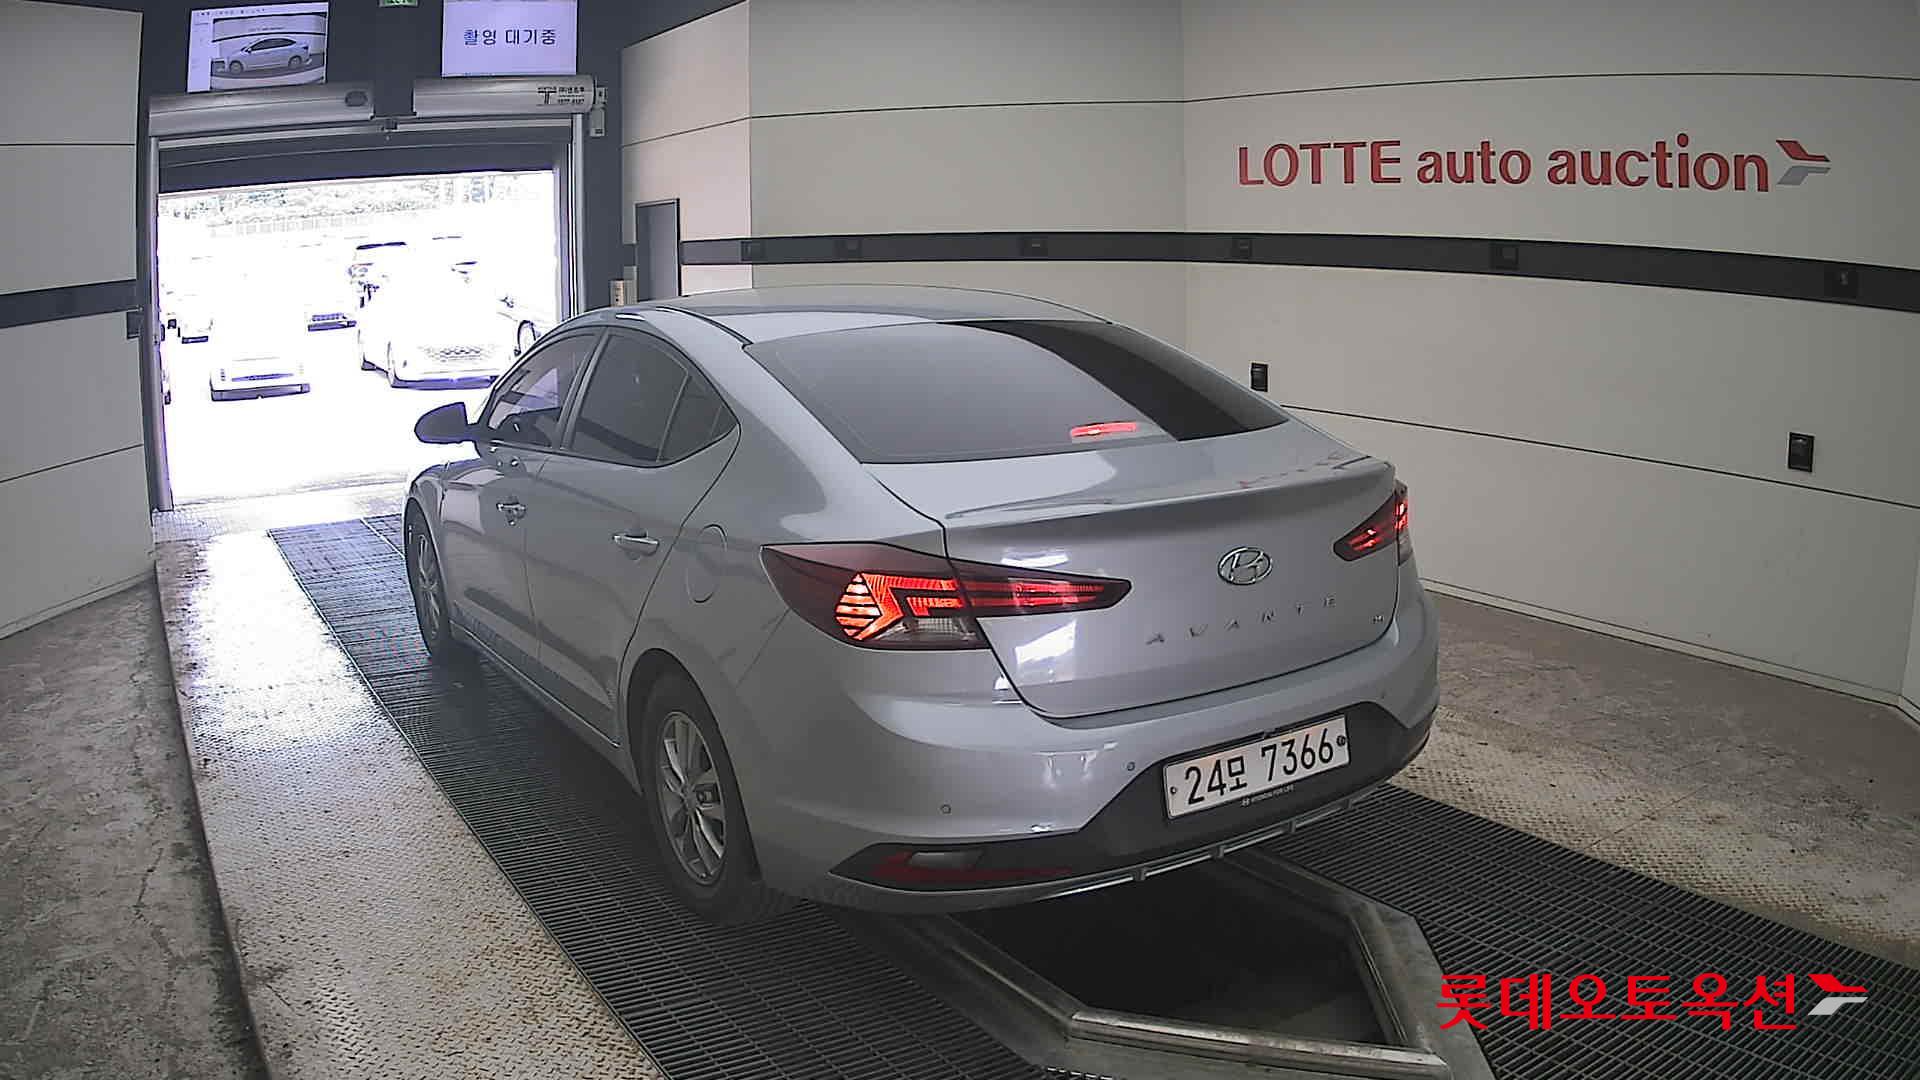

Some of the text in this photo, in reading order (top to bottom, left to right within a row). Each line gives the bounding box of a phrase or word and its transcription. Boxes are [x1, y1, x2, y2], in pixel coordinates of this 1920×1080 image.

[464, 29, 556, 46] 촬영 대기중
[1238, 133, 1769, 192] LOTTE auto auction
[1146, 596, 1335, 644] AVANTE
[1185, 728, 1333, 804] 24모 7366
